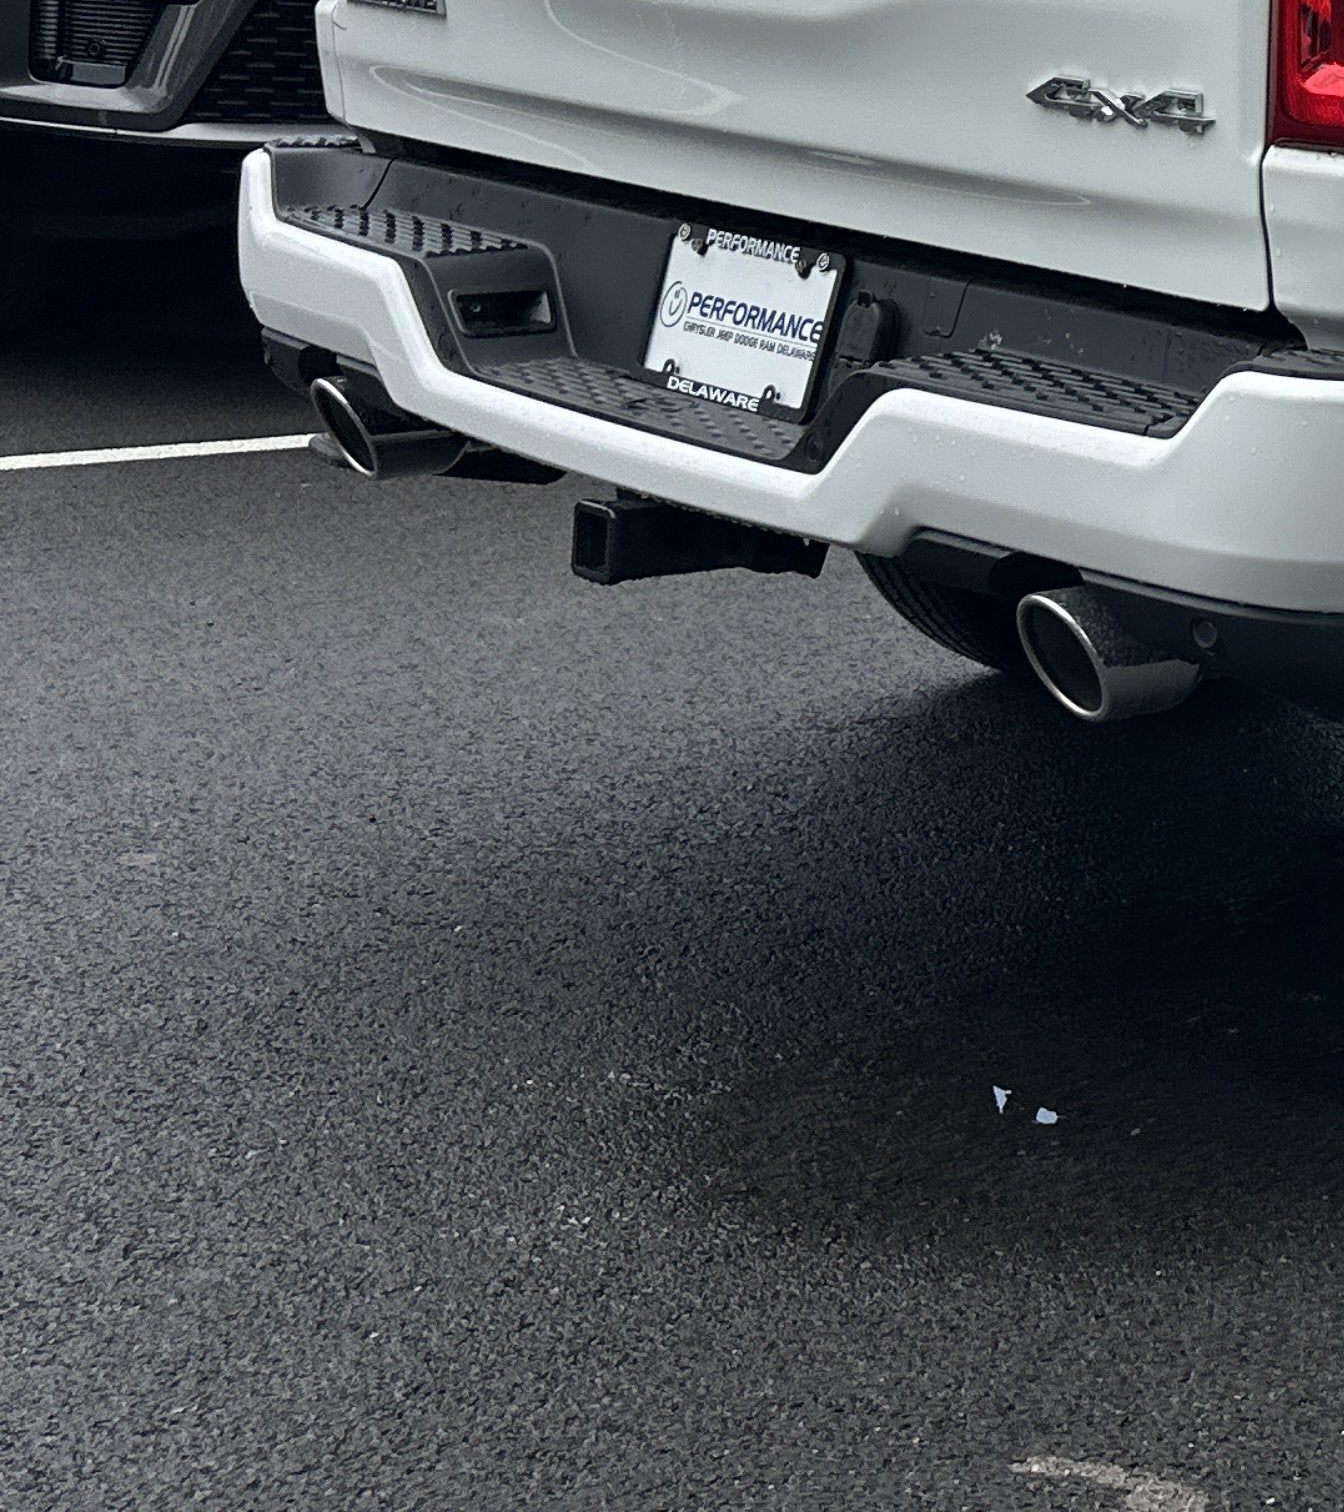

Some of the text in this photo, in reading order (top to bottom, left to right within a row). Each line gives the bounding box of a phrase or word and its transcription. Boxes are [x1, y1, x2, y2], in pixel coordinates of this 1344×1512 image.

[706, 228, 801, 264] PERFORMANCE
[687, 291, 825, 344] PERFORMANCE
[667, 376, 760, 413] DELAWARE
